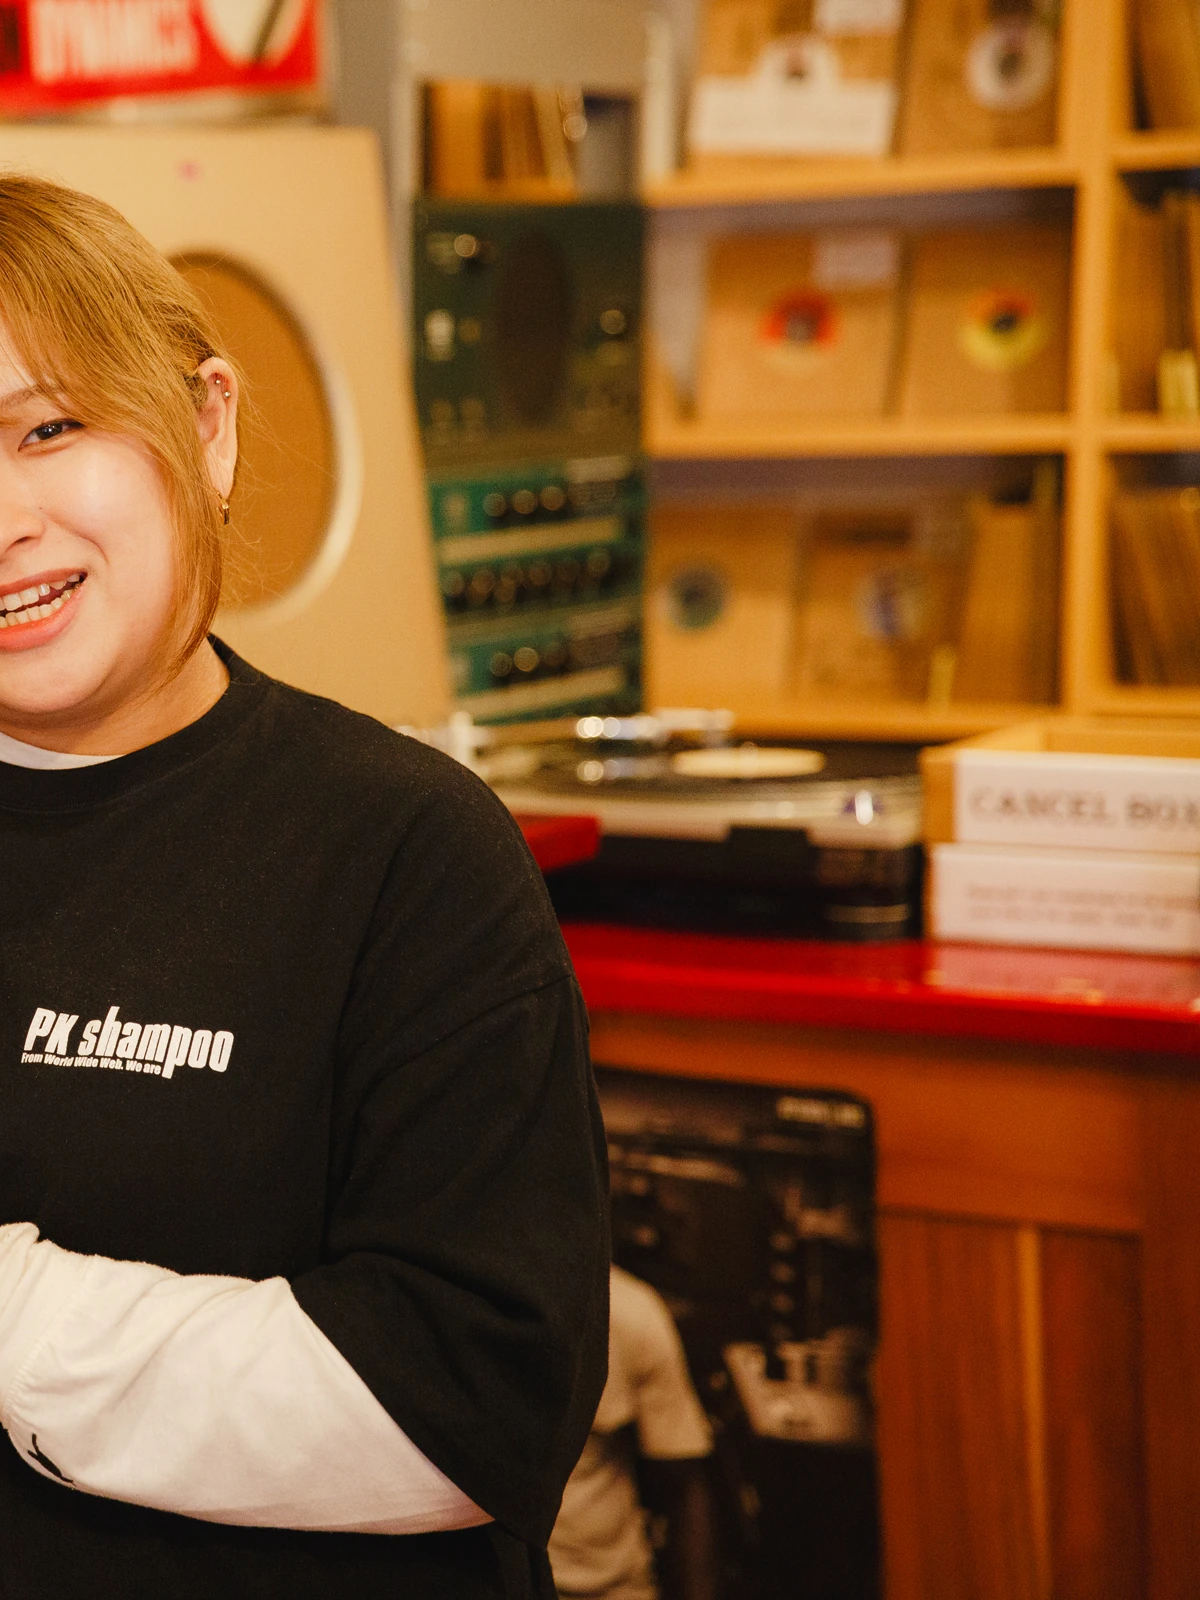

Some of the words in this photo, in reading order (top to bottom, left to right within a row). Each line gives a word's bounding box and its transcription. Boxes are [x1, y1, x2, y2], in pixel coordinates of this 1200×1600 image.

[21, 1052, 42, 1064] From
[44, 1054, 74, 1067] World
[74, 1056, 98, 1068] Wide
[100, 1058, 124, 1070] Web.
[126, 1060, 142, 1074] We
[143, 1063, 161, 1075] are
[24, 1007, 79, 1056] PK
[77, 1006, 234, 1080] shampoo
